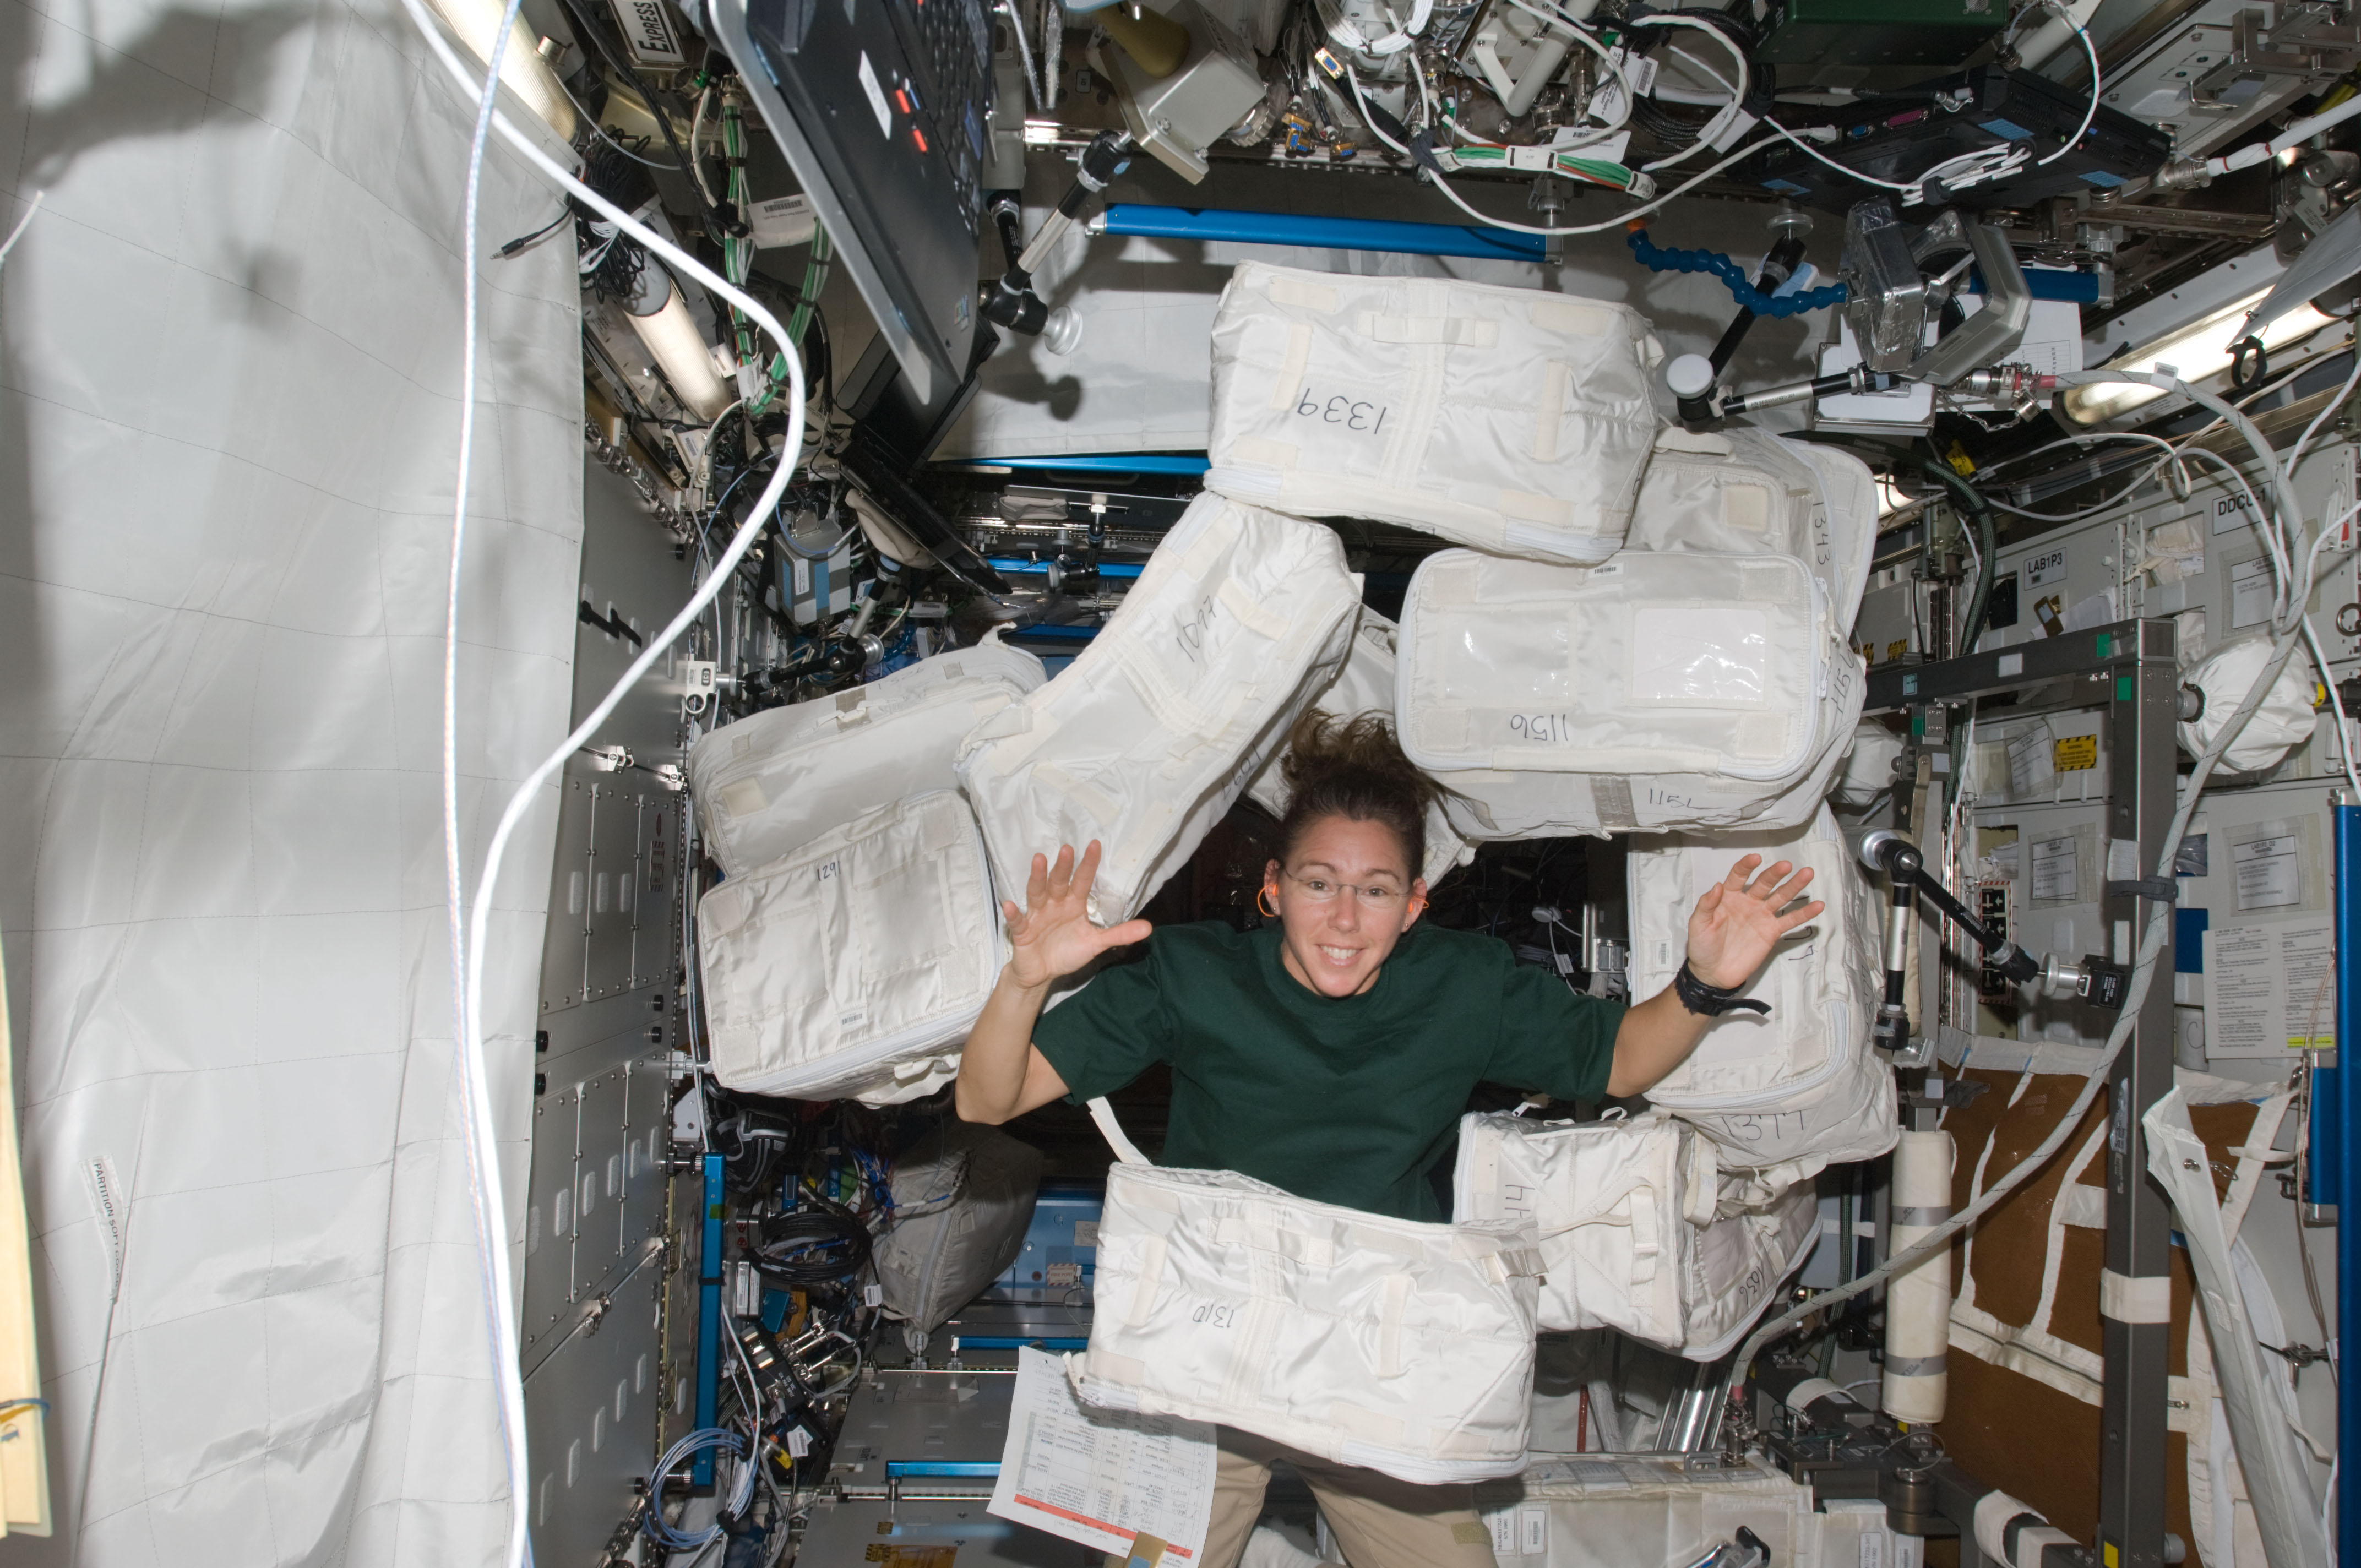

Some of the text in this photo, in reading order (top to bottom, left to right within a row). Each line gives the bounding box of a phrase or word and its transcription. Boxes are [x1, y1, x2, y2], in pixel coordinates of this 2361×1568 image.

[633, 2, 670, 53] EXPRESS
[1297, 388, 1386, 434] 1339
[1813, 502, 1830, 565] 1343
[2028, 552, 2063, 574] LAB1P3
[1510, 714, 1568, 742] 1156
[817, 860, 841, 881] 1291
[94, 1163, 114, 1217] PARTITION
[109, 1219, 119, 1245] SOFT
[1192, 1304, 1234, 1328] 1310
